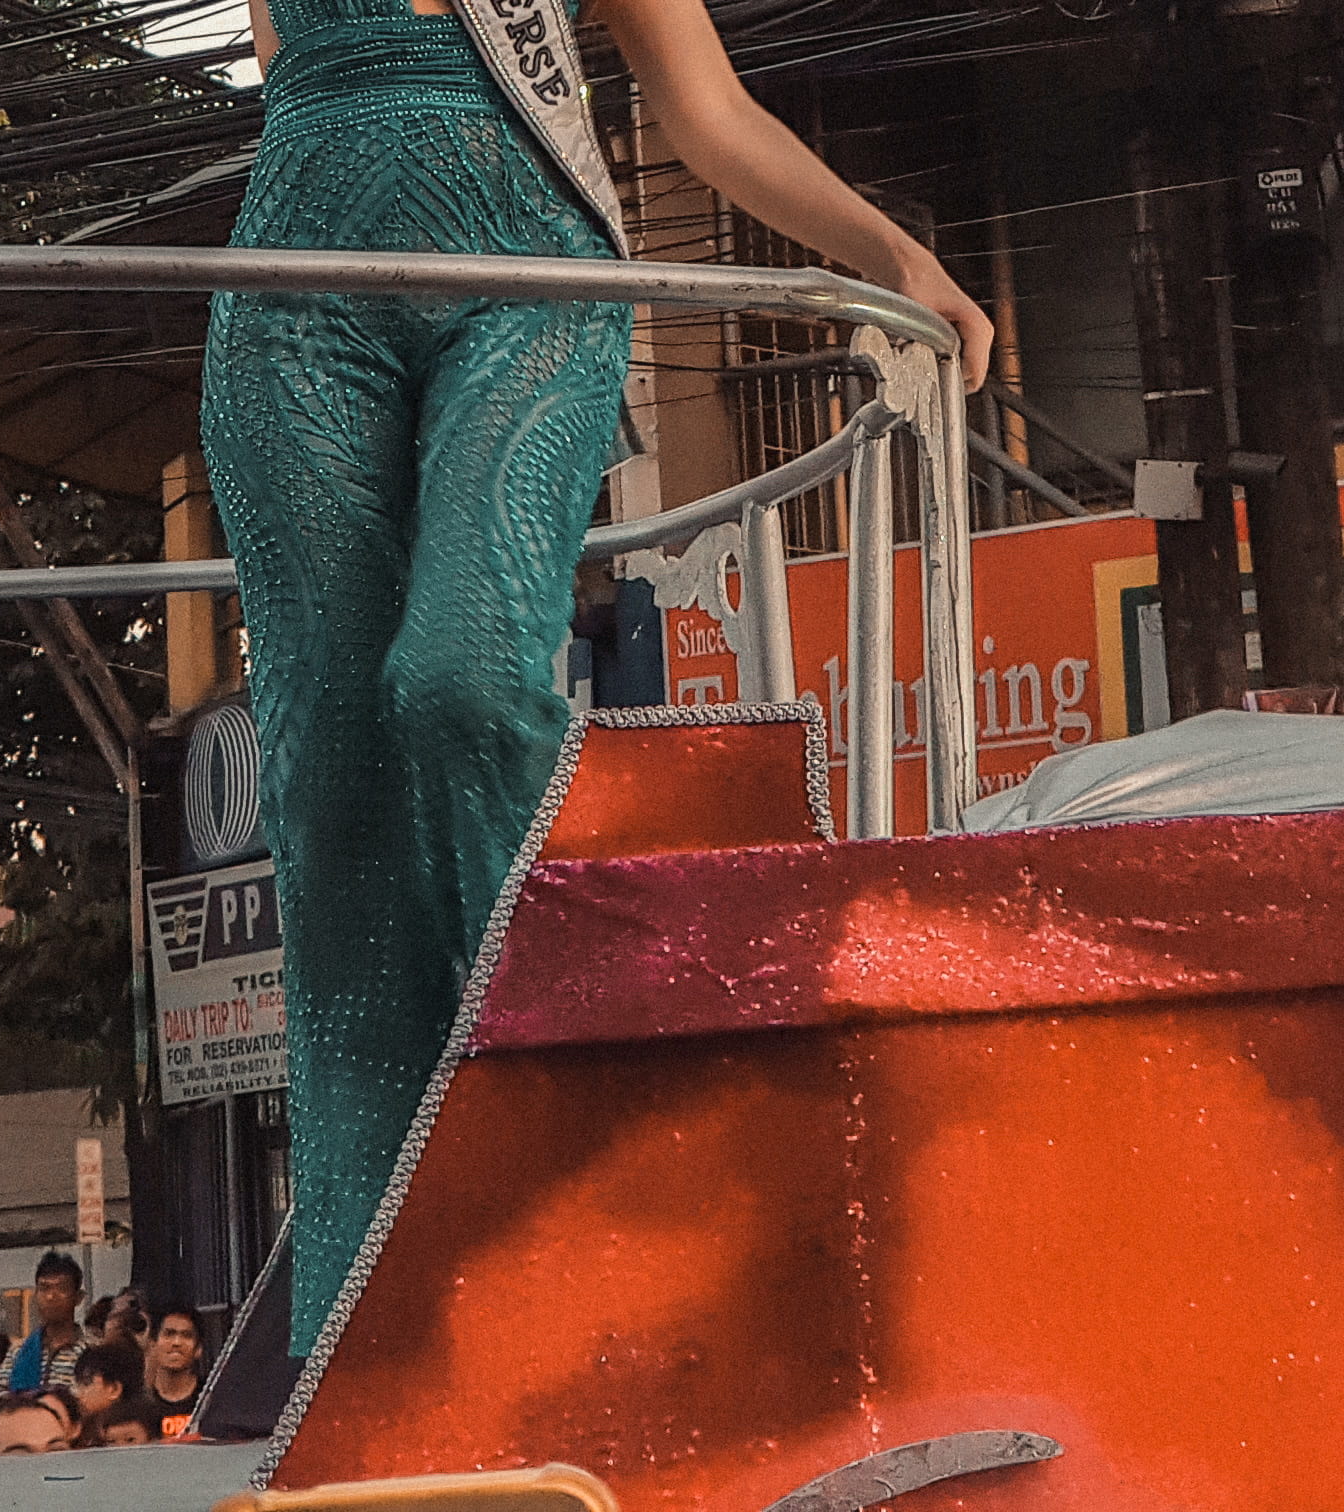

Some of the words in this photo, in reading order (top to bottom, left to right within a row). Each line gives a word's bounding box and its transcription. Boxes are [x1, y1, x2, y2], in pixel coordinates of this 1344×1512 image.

[677, 618, 727, 658] Since
[164, 1009, 197, 1044] DAILY
[201, 1001, 229, 1038] TRIP
[166, 1046, 192, 1065] FOR
[183, 1076, 273, 1096] RELIABILITY
